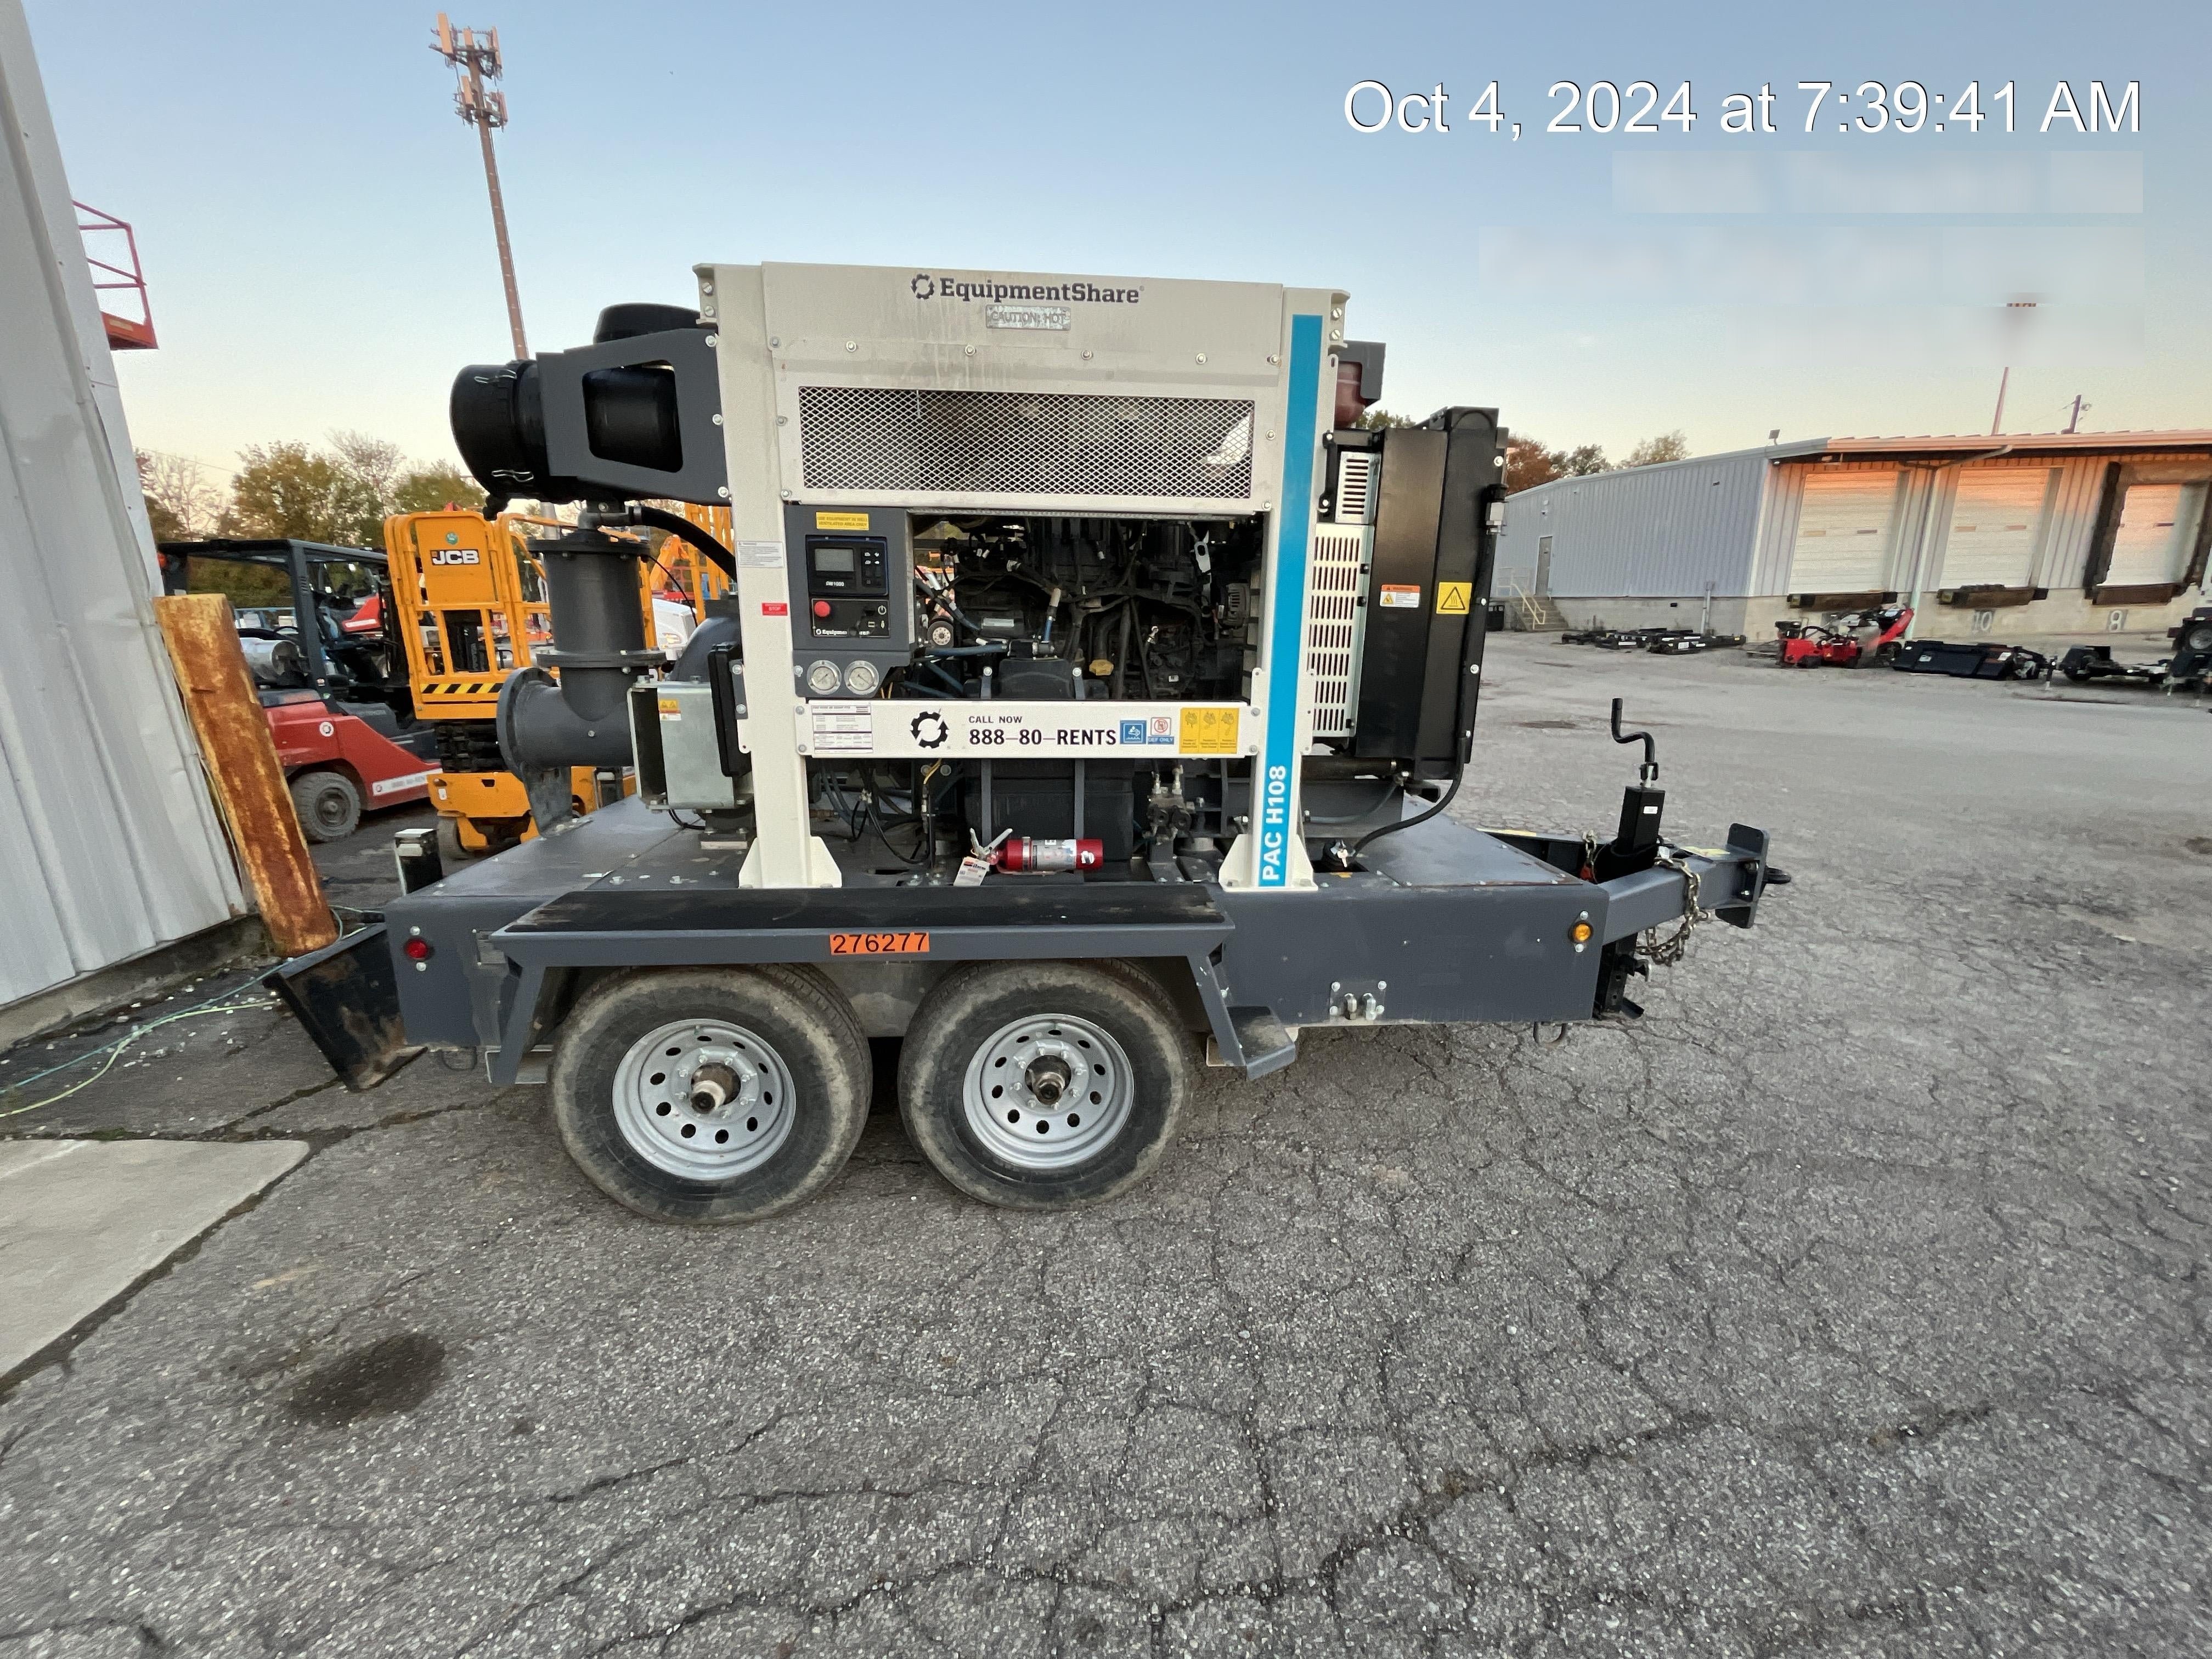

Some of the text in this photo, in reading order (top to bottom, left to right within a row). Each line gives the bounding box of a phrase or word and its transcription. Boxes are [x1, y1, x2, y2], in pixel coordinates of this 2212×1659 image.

[940, 277, 1140, 303] EquipmentShare
[431, 550, 479, 565] JCB
[1972, 611, 1993, 632] 10
[2109, 610, 2123, 633] 8
[1262, 765, 1287, 881] PAC H108
[833, 932, 928, 953] 276277
